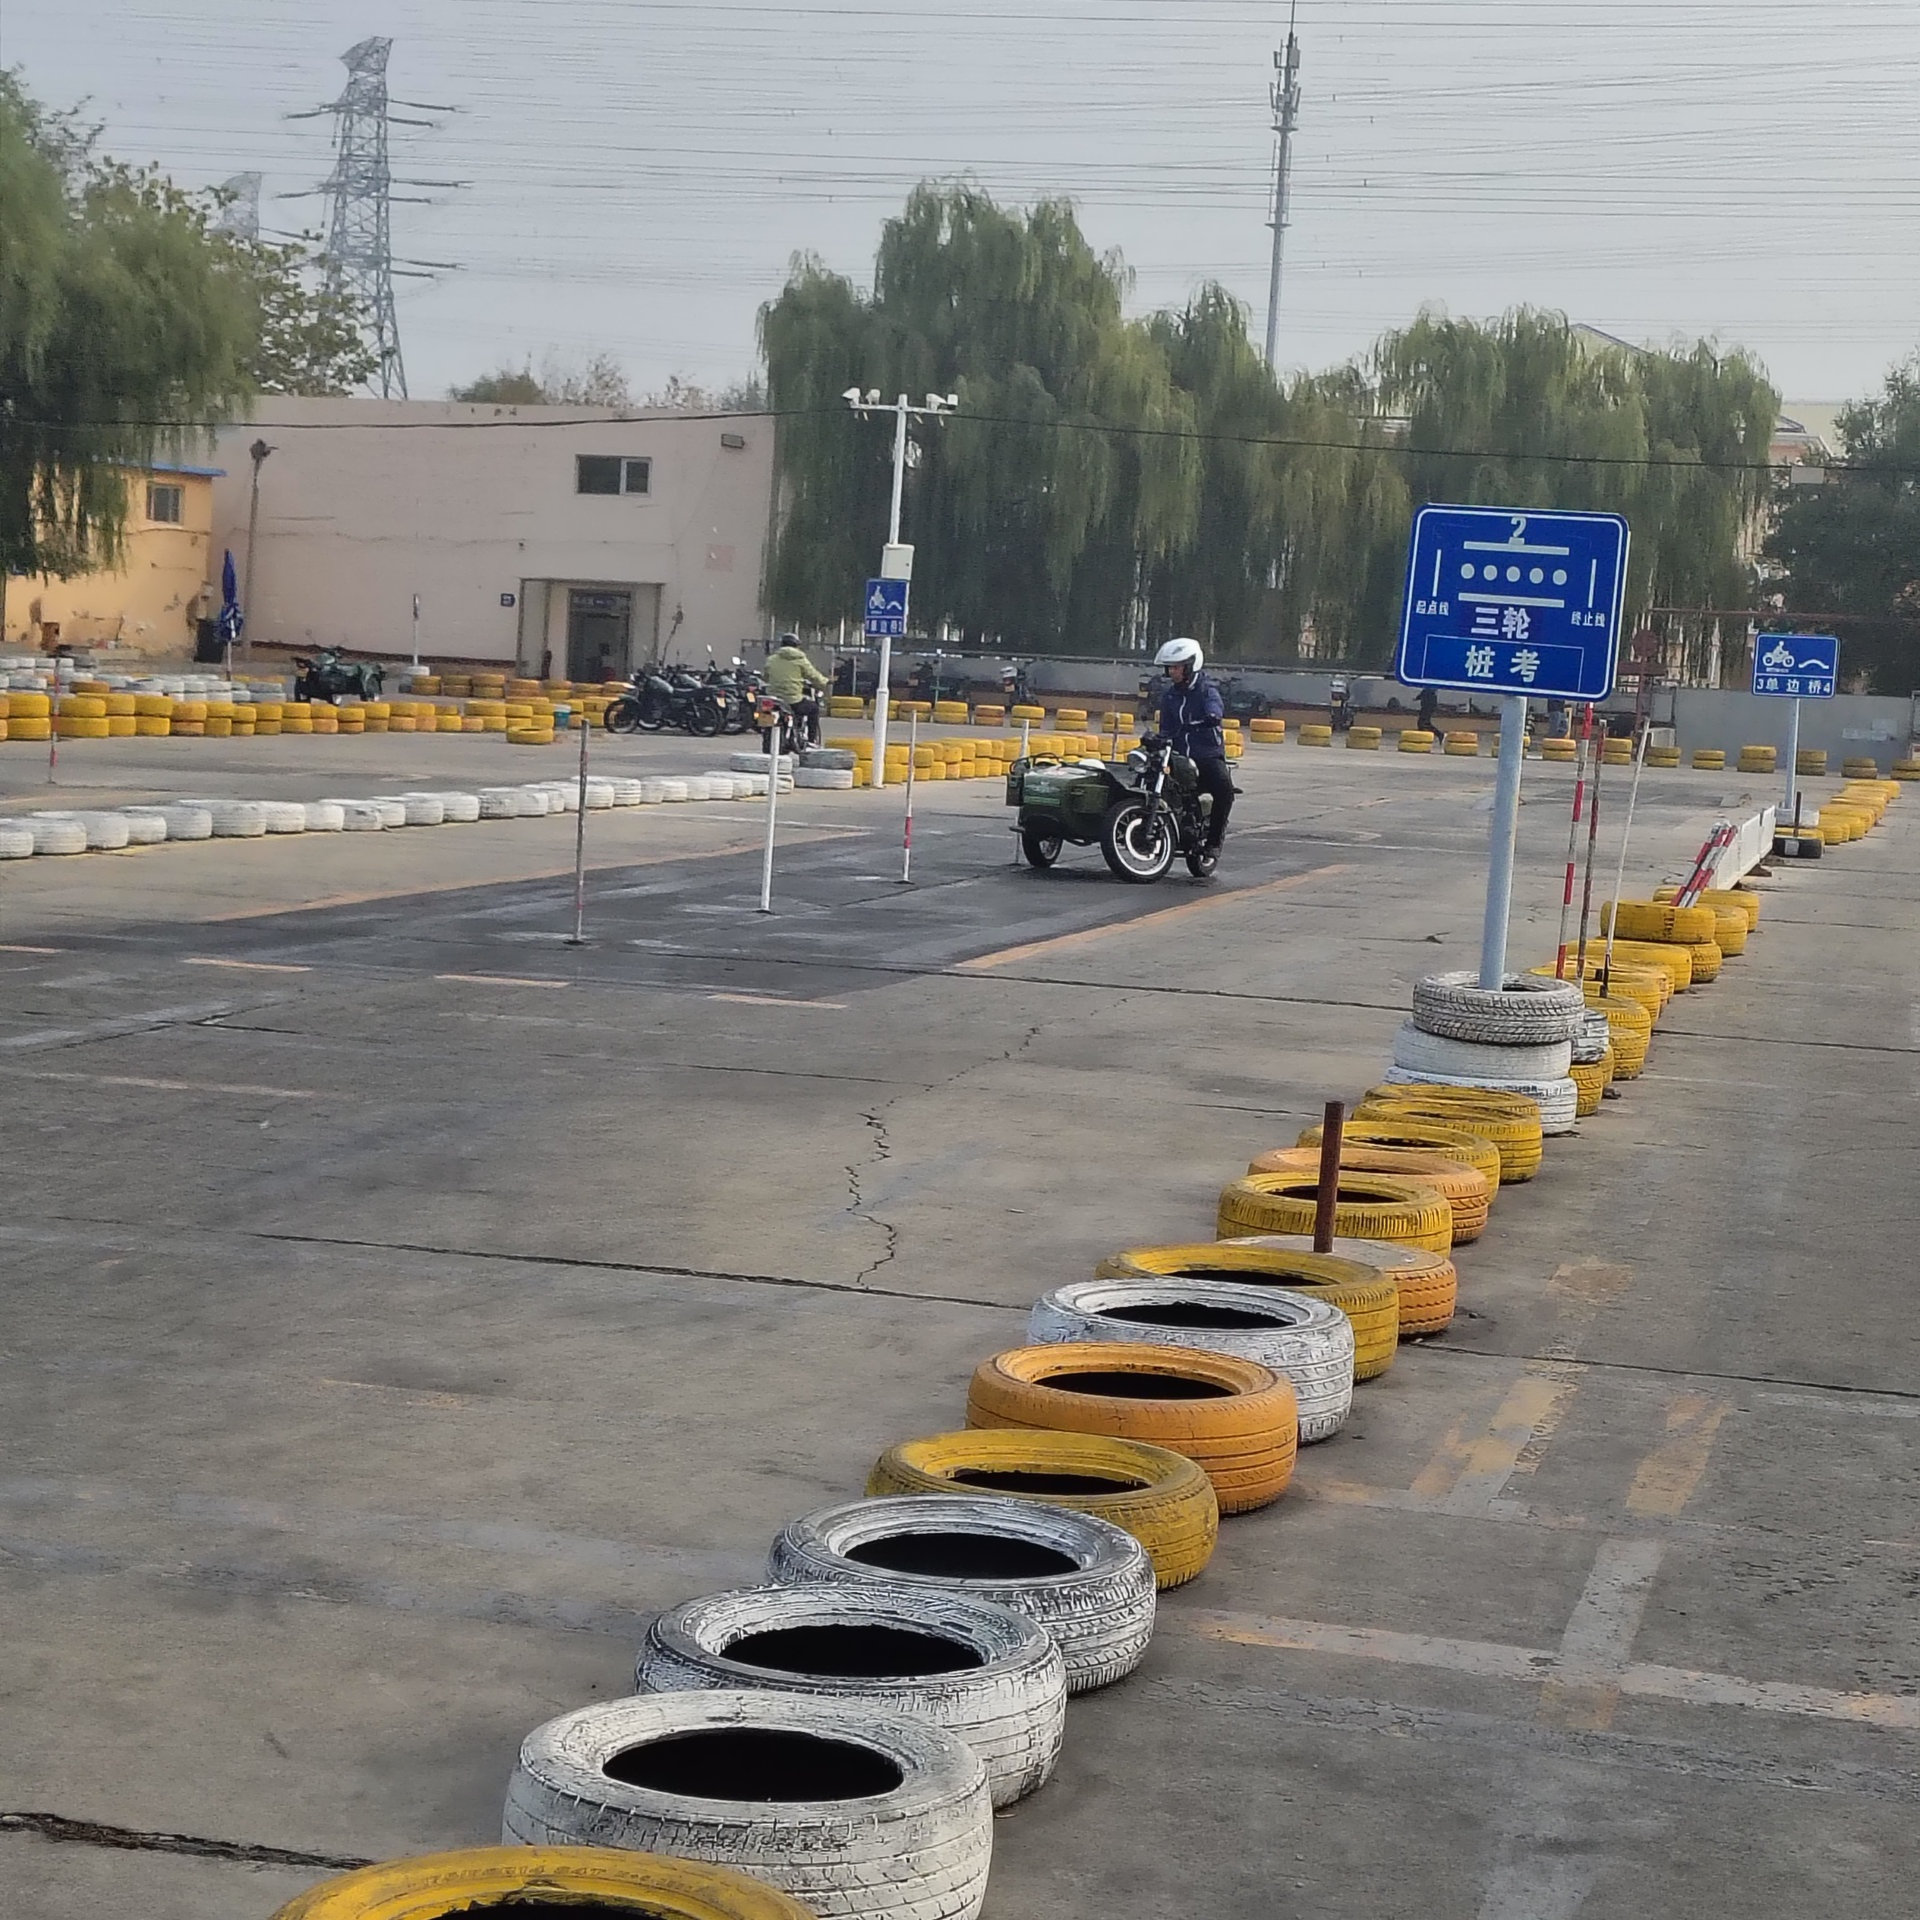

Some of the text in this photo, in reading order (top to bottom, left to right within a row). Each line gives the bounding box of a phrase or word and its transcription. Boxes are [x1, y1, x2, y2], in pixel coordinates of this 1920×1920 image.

[1509, 516, 1526, 546] 2
[1416, 600, 1449, 616] 起点线
[1571, 611, 1605, 628] 终止线
[1471, 606, 1531, 639] 三轮
